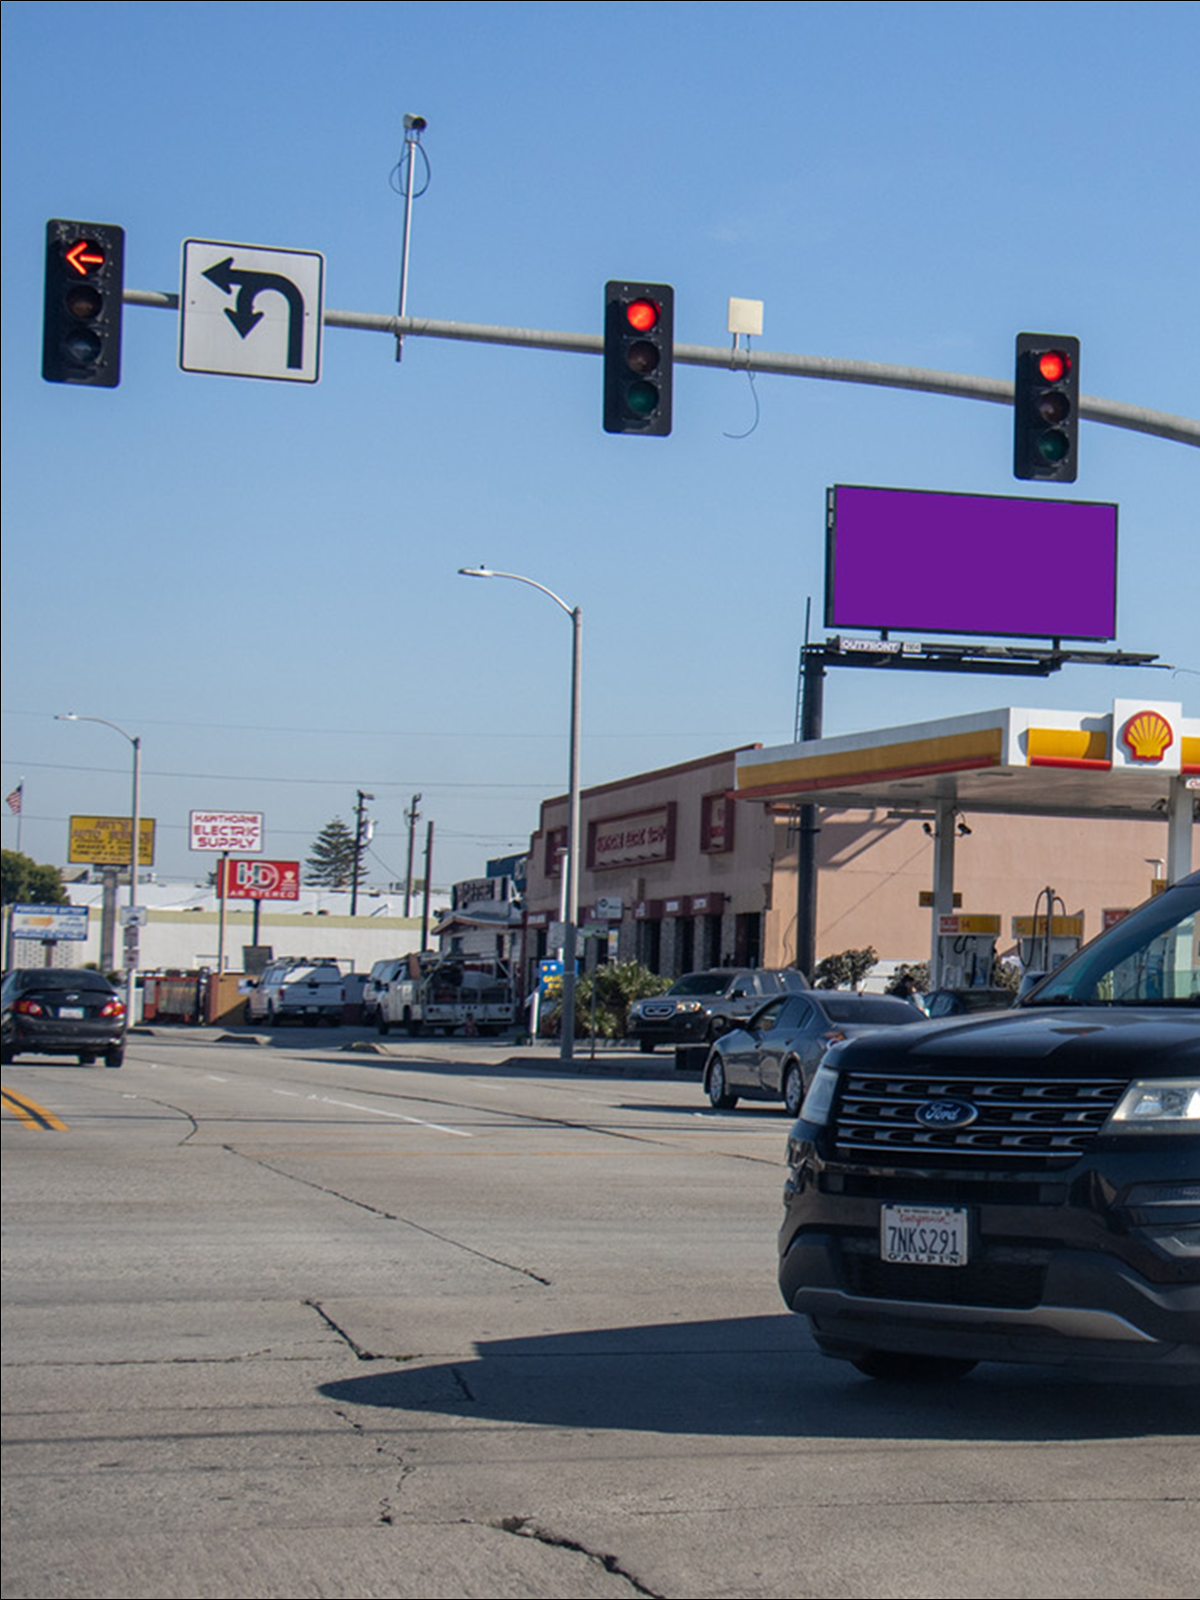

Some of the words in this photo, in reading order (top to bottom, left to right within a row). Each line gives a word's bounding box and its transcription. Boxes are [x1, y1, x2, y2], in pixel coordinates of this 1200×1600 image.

[194, 814, 259, 824] HAWTHORNE
[193, 825, 260, 837] ELECTRIC
[197, 837, 256, 849] SUPPLY
[924, 1103, 960, 1121] Ford
[888, 1226, 960, 1256] 7NKS291
[887, 1253, 960, 1264] GALPIN
